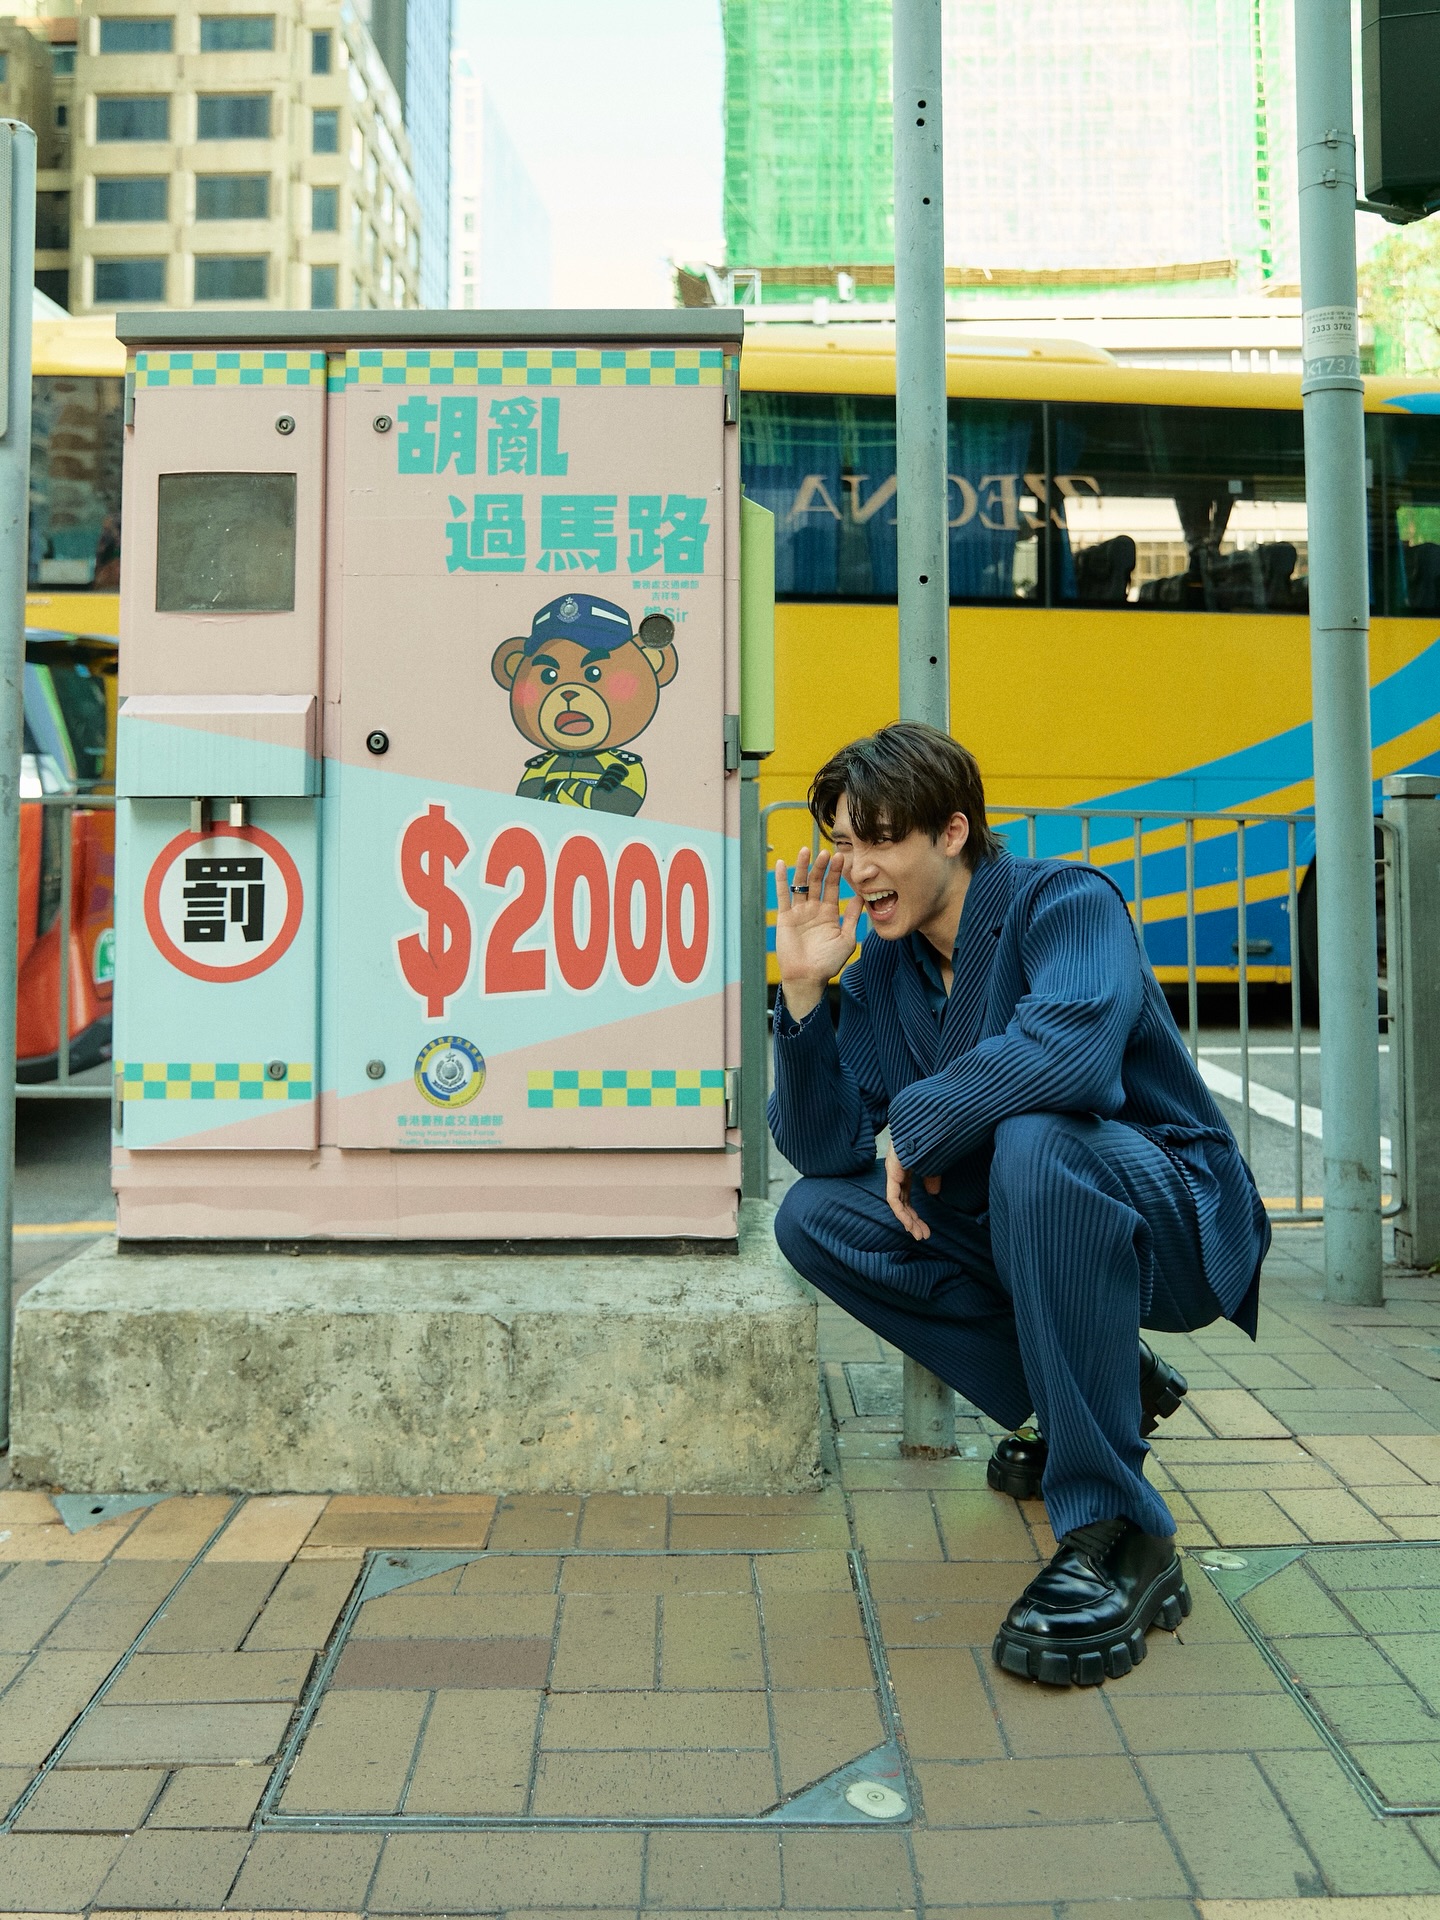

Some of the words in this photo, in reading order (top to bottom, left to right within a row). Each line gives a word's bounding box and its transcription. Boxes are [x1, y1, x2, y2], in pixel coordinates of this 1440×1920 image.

[1312, 324, 1331, 334] 2333
[1334, 323, 1352, 331] 3762
[397, 395, 569, 476] 胡亂
[445, 494, 710, 574] 過馬路
[182, 857, 265, 943] 罰
[397, 804, 709, 1018] $2000
